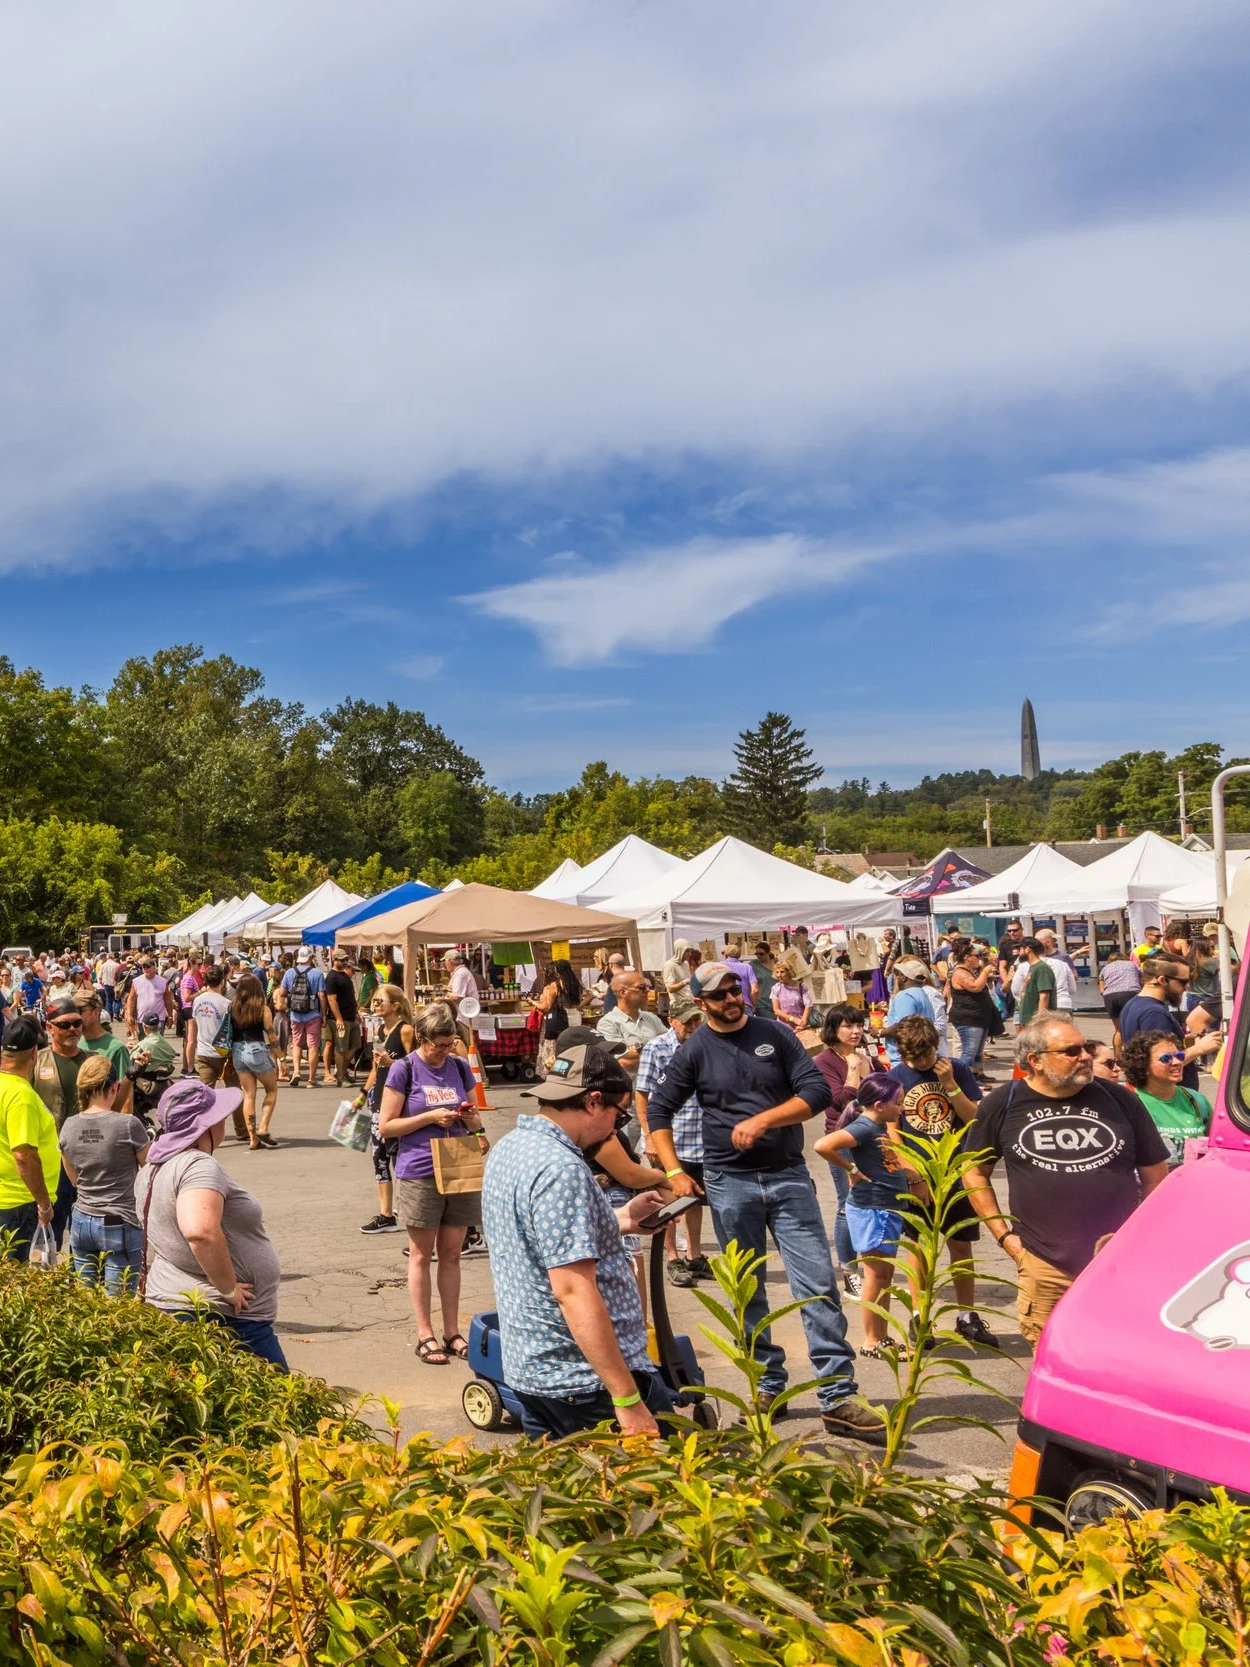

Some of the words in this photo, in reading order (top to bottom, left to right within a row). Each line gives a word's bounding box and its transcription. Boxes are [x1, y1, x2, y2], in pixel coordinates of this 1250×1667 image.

[904, 1089, 921, 1107] GAS
[1026, 1106, 1071, 1121] 102.7
[1080, 1107, 1099, 1119] fm
[1033, 1127, 1103, 1151] EQX
[1012, 1143, 1027, 1160] the
[1031, 1159, 1058, 1172] real
[1065, 1139, 1125, 1173] alternative
